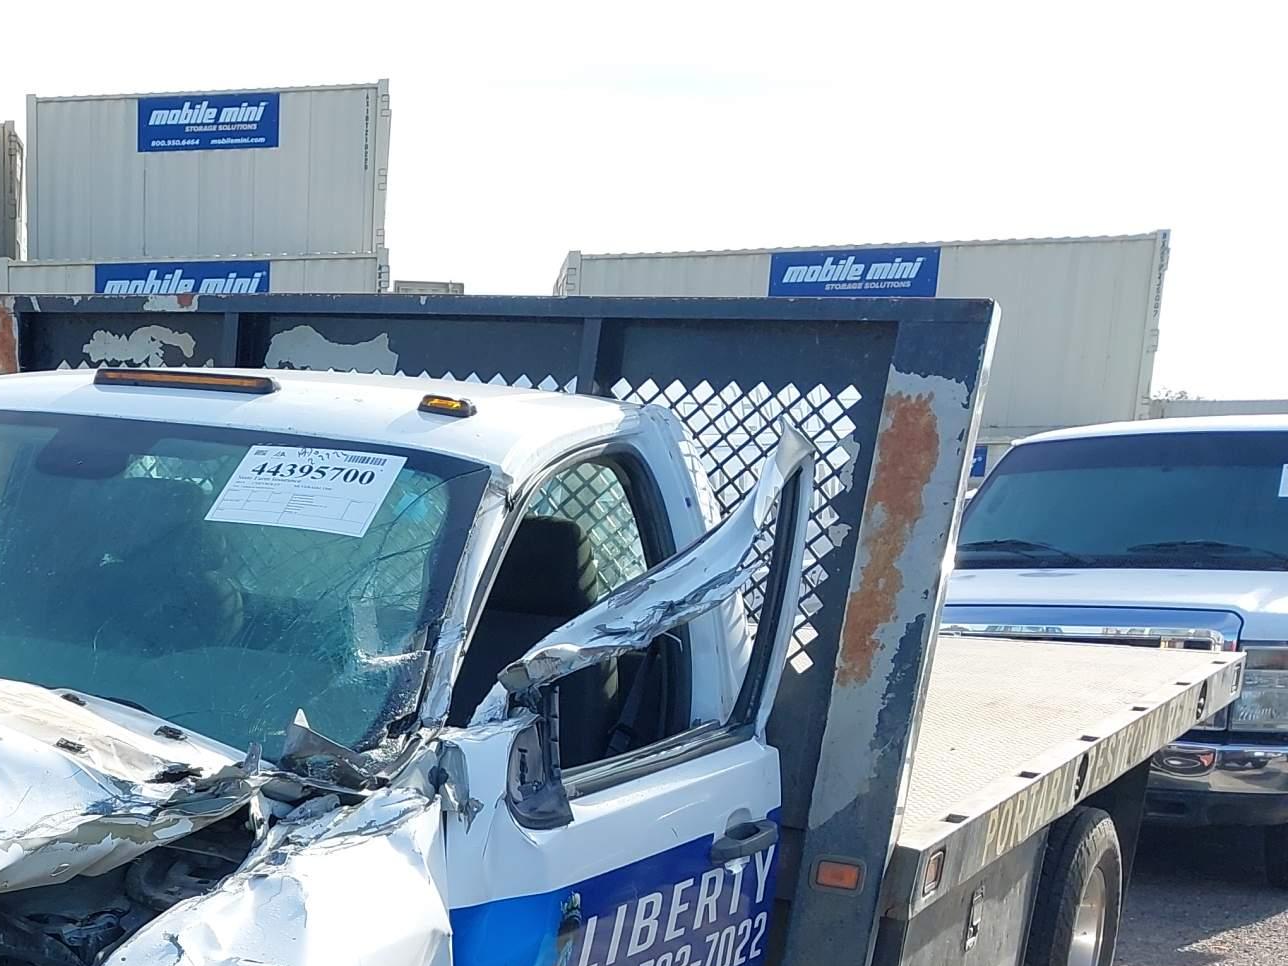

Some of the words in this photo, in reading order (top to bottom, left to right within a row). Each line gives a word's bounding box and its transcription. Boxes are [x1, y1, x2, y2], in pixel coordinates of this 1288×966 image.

[148, 101, 218, 125] mobile
[218, 102, 265, 123] mini
[218, 123, 257, 131] SOLUTIONS
[210, 137, 266, 145] mobilemini.com
[782, 256, 865, 284] mobile
[865, 257, 923, 280] mini
[198, 272, 262, 294] mini
[825, 282, 862, 291] STORAGE
[864, 281, 912, 289] SOLUTIONS
[251, 461, 376, 486] 44395700
